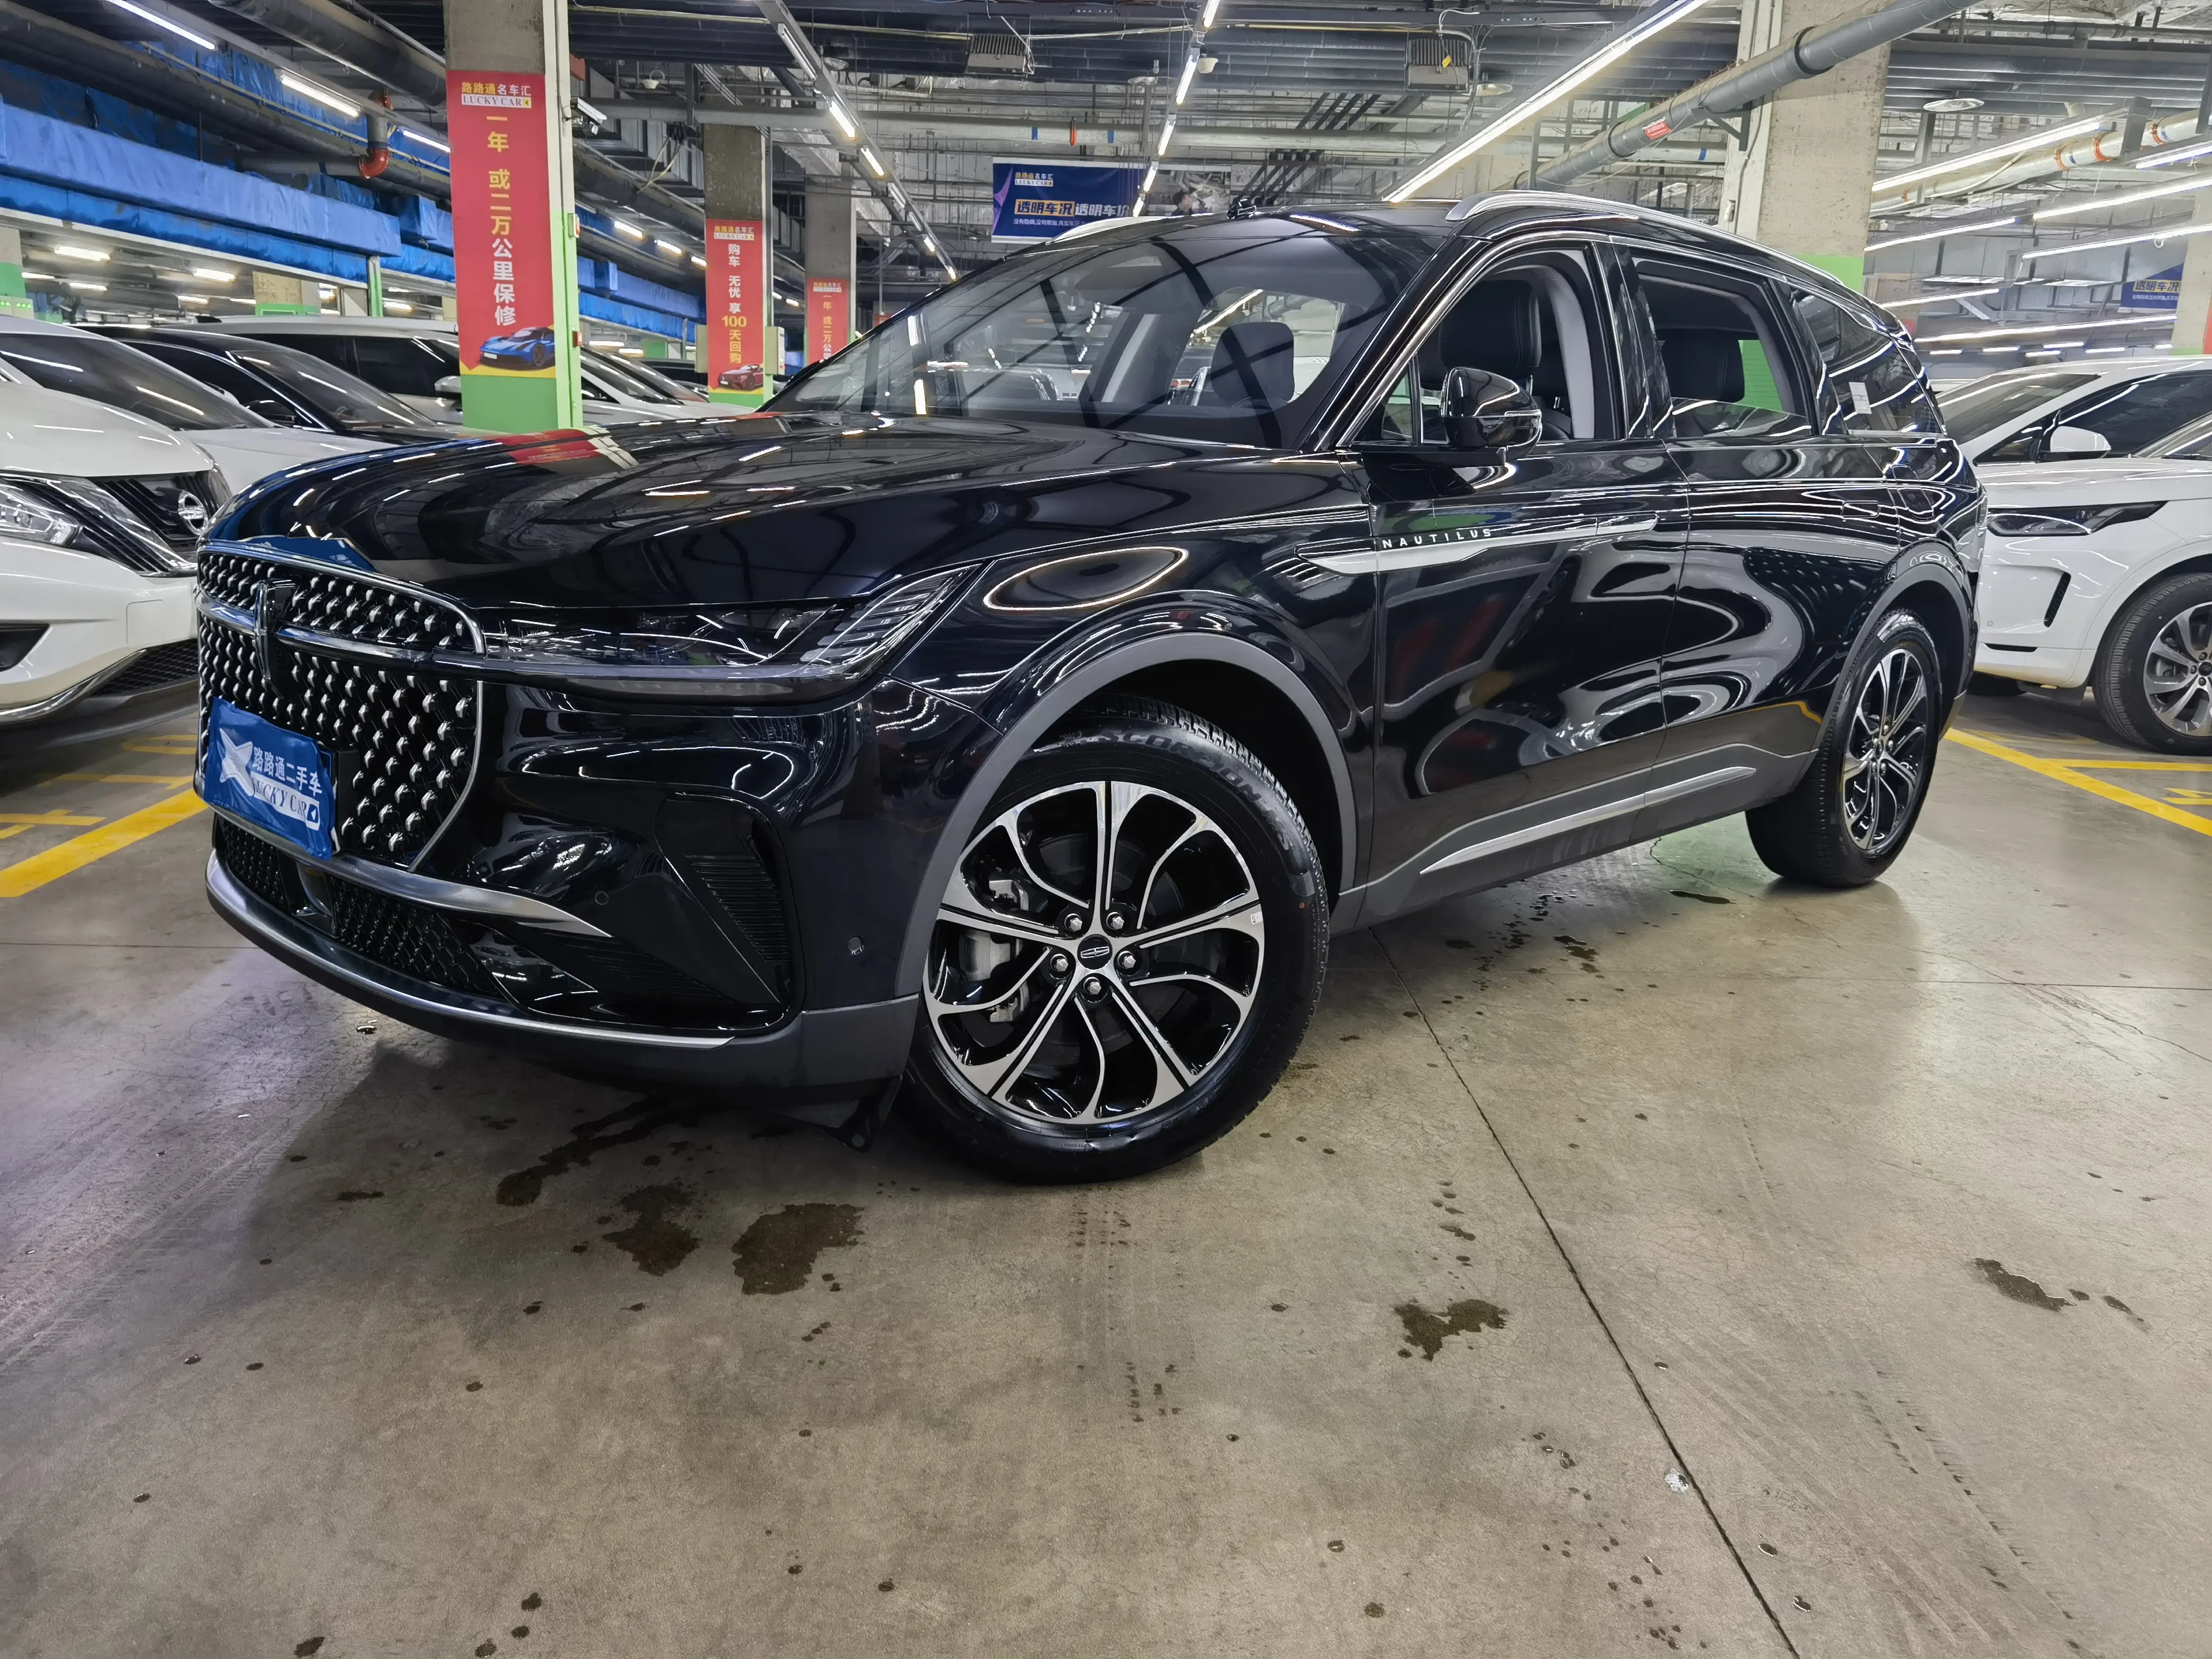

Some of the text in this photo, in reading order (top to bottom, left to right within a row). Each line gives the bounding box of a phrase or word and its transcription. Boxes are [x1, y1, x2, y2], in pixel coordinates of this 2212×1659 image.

[461, 82, 531, 97] 路路通名车汇
[462, 96, 522, 106] LUCKY CAR
[488, 168, 517, 326] 或二万公里保修
[728, 244, 740, 267] 购车
[1381, 529, 1492, 549] NAUTILUS
[252, 746, 322, 797] 路路通二手车
[290, 794, 307, 820] CAR
